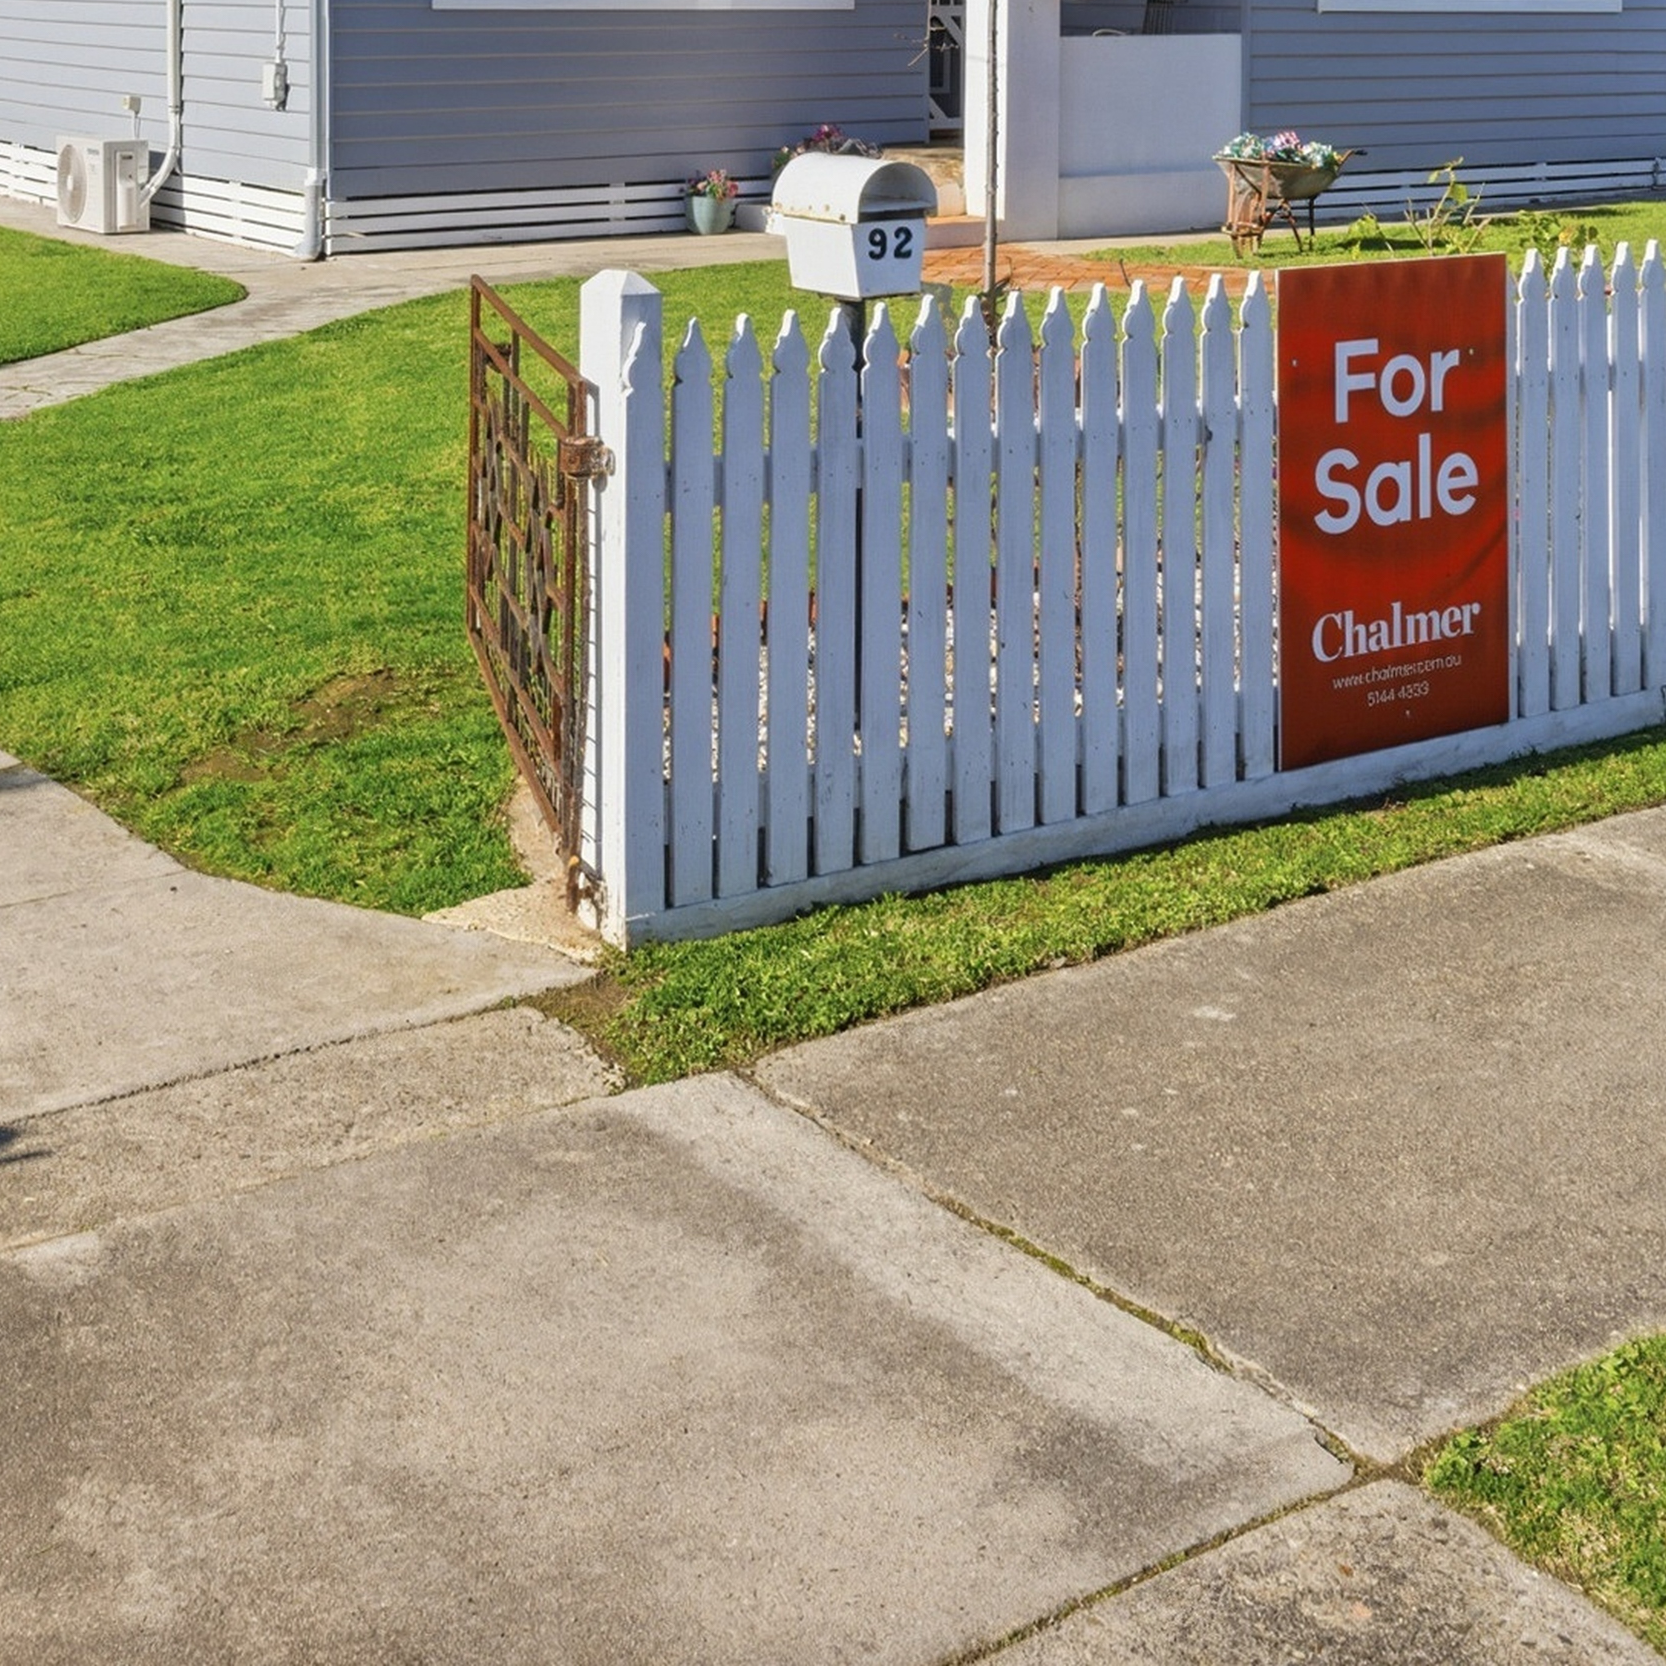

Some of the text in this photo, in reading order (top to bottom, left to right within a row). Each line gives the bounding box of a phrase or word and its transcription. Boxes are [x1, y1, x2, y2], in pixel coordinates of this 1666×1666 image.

[868, 226, 913, 260] 92
[1335, 338, 1460, 423] For
[1314, 433, 1479, 534] Sale
[1311, 601, 1481, 663] Chalmer
[1367, 689, 1395, 707] 5144
